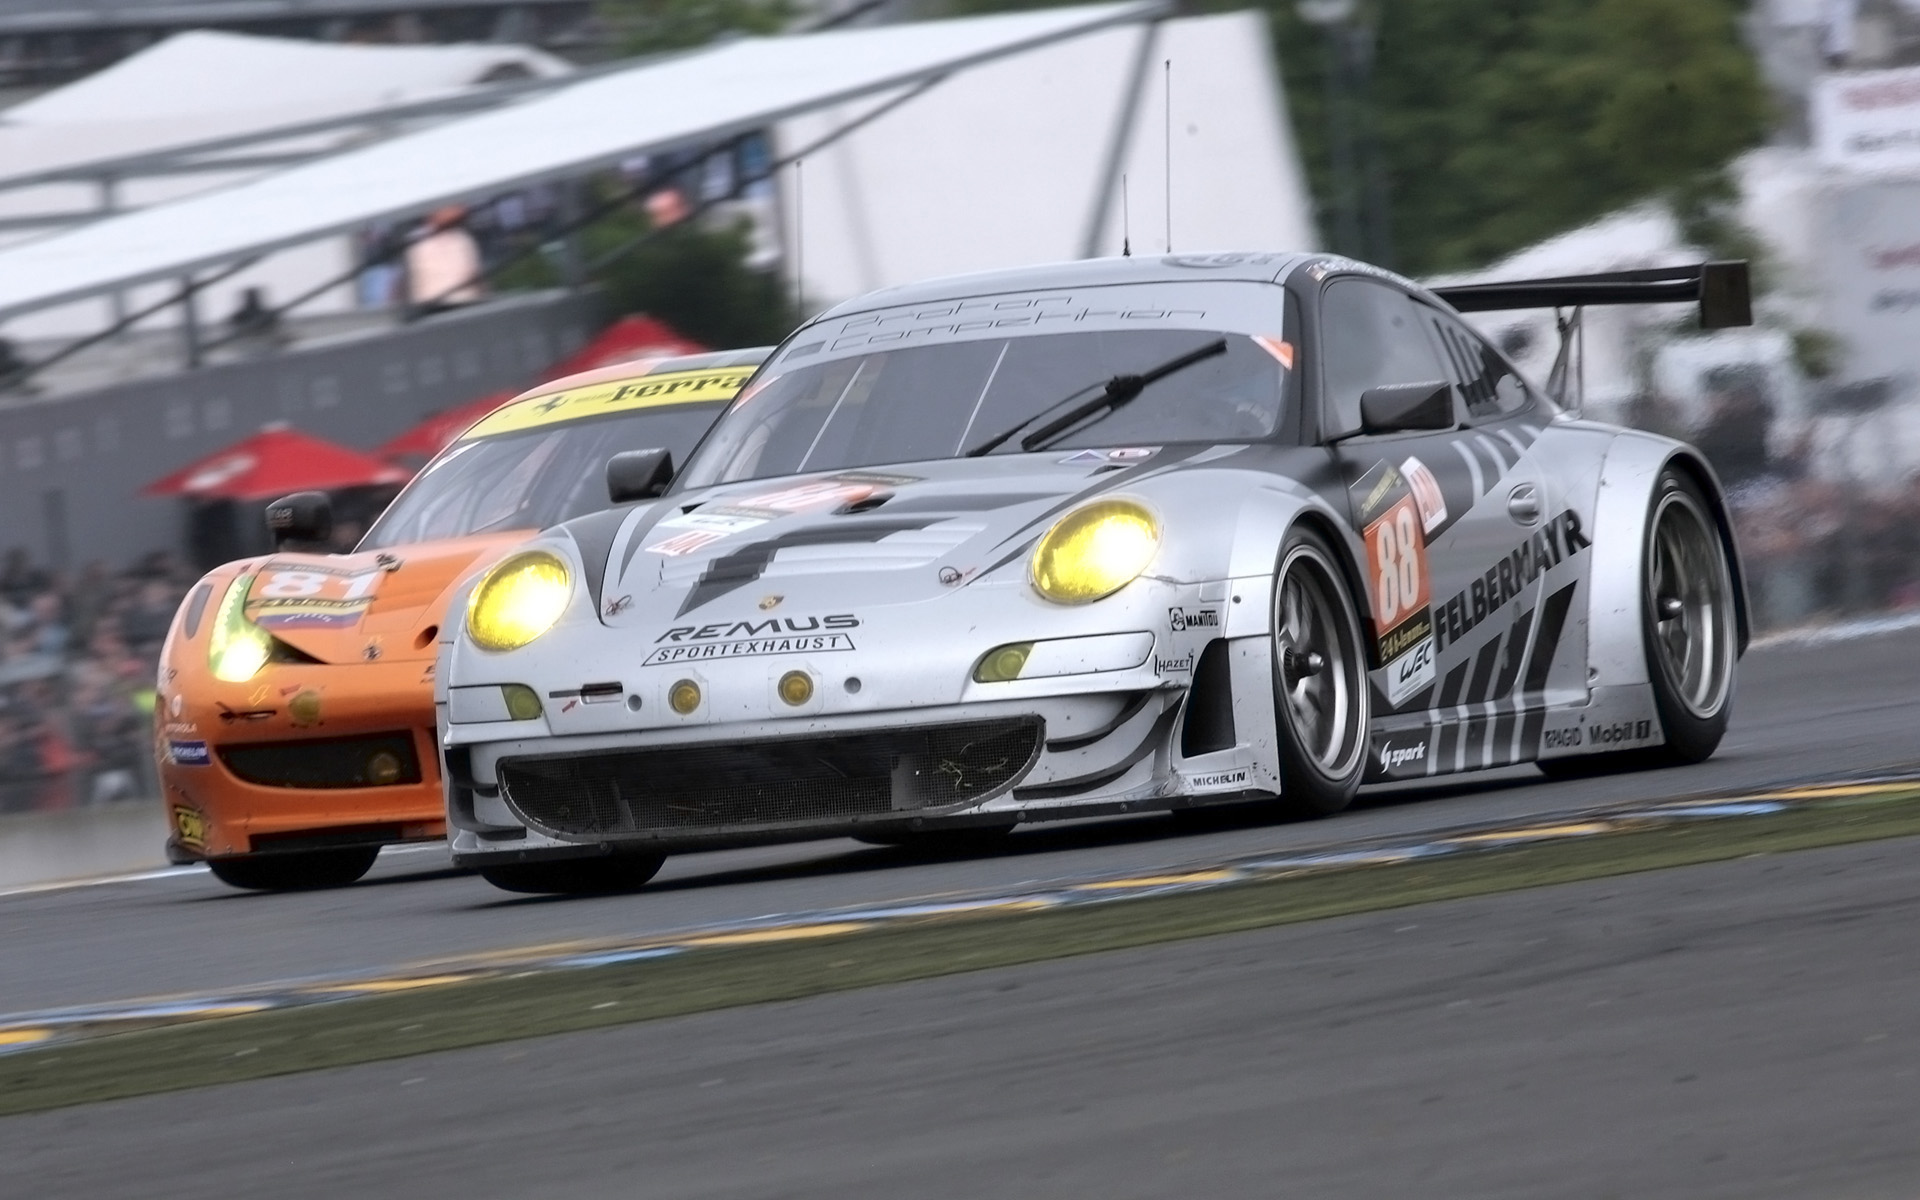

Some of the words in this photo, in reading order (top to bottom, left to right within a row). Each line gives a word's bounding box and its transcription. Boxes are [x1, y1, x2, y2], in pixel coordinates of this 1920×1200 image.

[1376, 506, 1420, 626] 88
[259, 571, 379, 600] 81
[1435, 508, 1592, 654] FELBERMAYR
[653, 613, 861, 644] REMUS
[1185, 610, 1219, 627] MANITOU
[657, 635, 843, 662] SPORTEXHAUST
[1400, 641, 1432, 684] WEC
[1158, 659, 1191, 673] HAZET
[1589, 721, 1632, 745] Mobil
[1636, 719, 1651, 740] 1
[1192, 771, 1246, 787] MICHELIN
